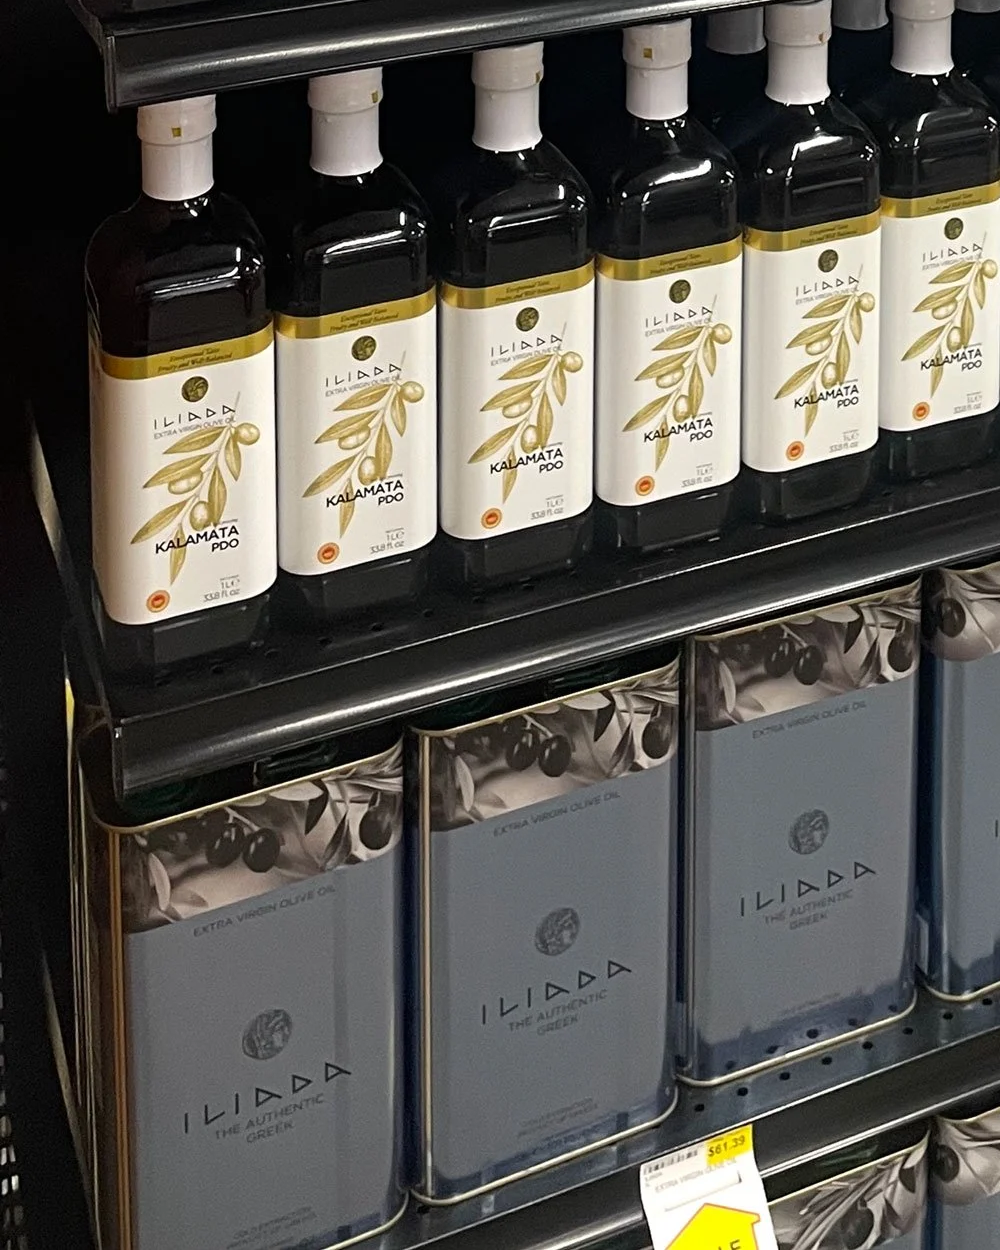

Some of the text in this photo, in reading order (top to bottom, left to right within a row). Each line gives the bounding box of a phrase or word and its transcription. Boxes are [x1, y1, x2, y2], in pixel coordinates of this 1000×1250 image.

[796, 276, 859, 296] ILIADA
[325, 363, 401, 387] ILIADA
[794, 384, 858, 408] KALAMATA
[838, 396, 858, 408] PDO
[154, 405, 235, 429] ILIADA
[326, 479, 403, 507] KALAMATA
[155, 524, 239, 553] KALAMATA
[211, 539, 239, 552] PDO
[741, 861, 876, 917] ILIADA
[193, 885, 335, 937] EXTRA VIRGIN OLIVE OIL
[482, 960, 631, 1024] ILIADA
[184, 1063, 351, 1133] ILIADA
[215, 1095, 324, 1139] THE AUTHENTIC
[247, 1122, 293, 1143] GREEK
[708, 1135, 744, 1157] $61.39
